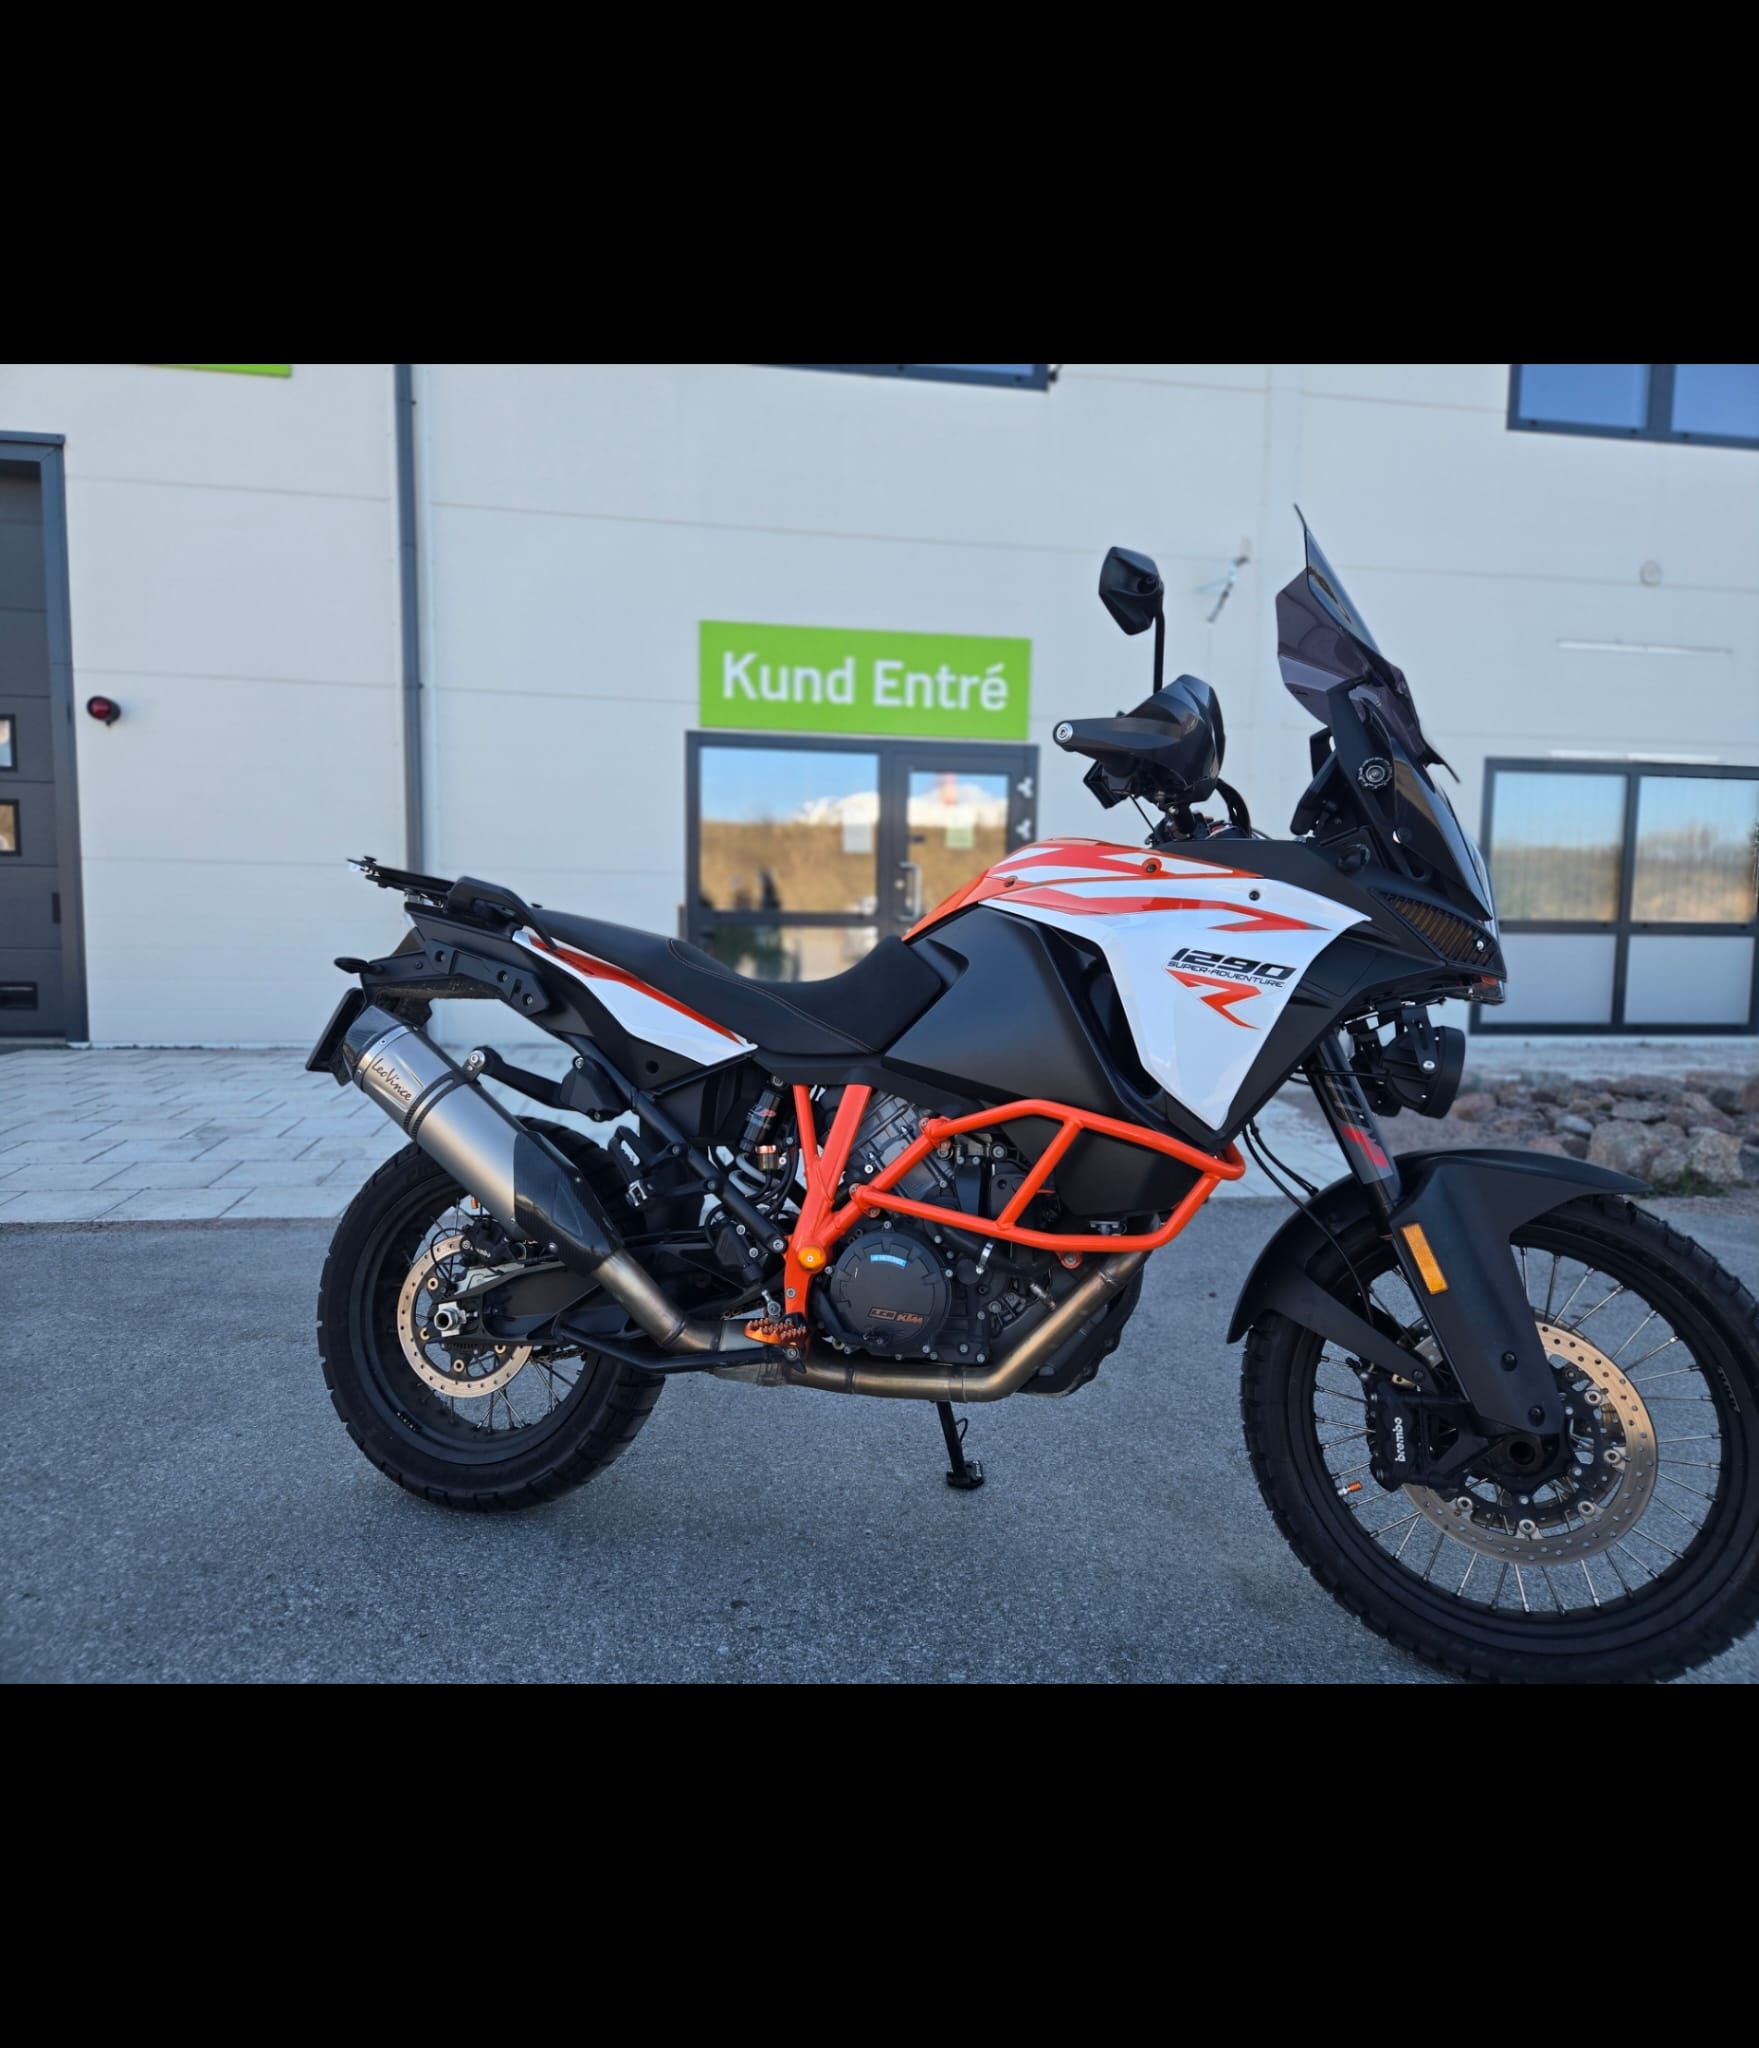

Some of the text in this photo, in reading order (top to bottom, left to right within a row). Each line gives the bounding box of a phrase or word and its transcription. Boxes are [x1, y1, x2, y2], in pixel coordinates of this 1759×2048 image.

[722, 650, 1009, 712] Kund Entré
[1170, 947, 1298, 981] 1290
[371, 1057, 412, 1101] LeoVince
[1392, 1416, 1406, 1462] brembo
